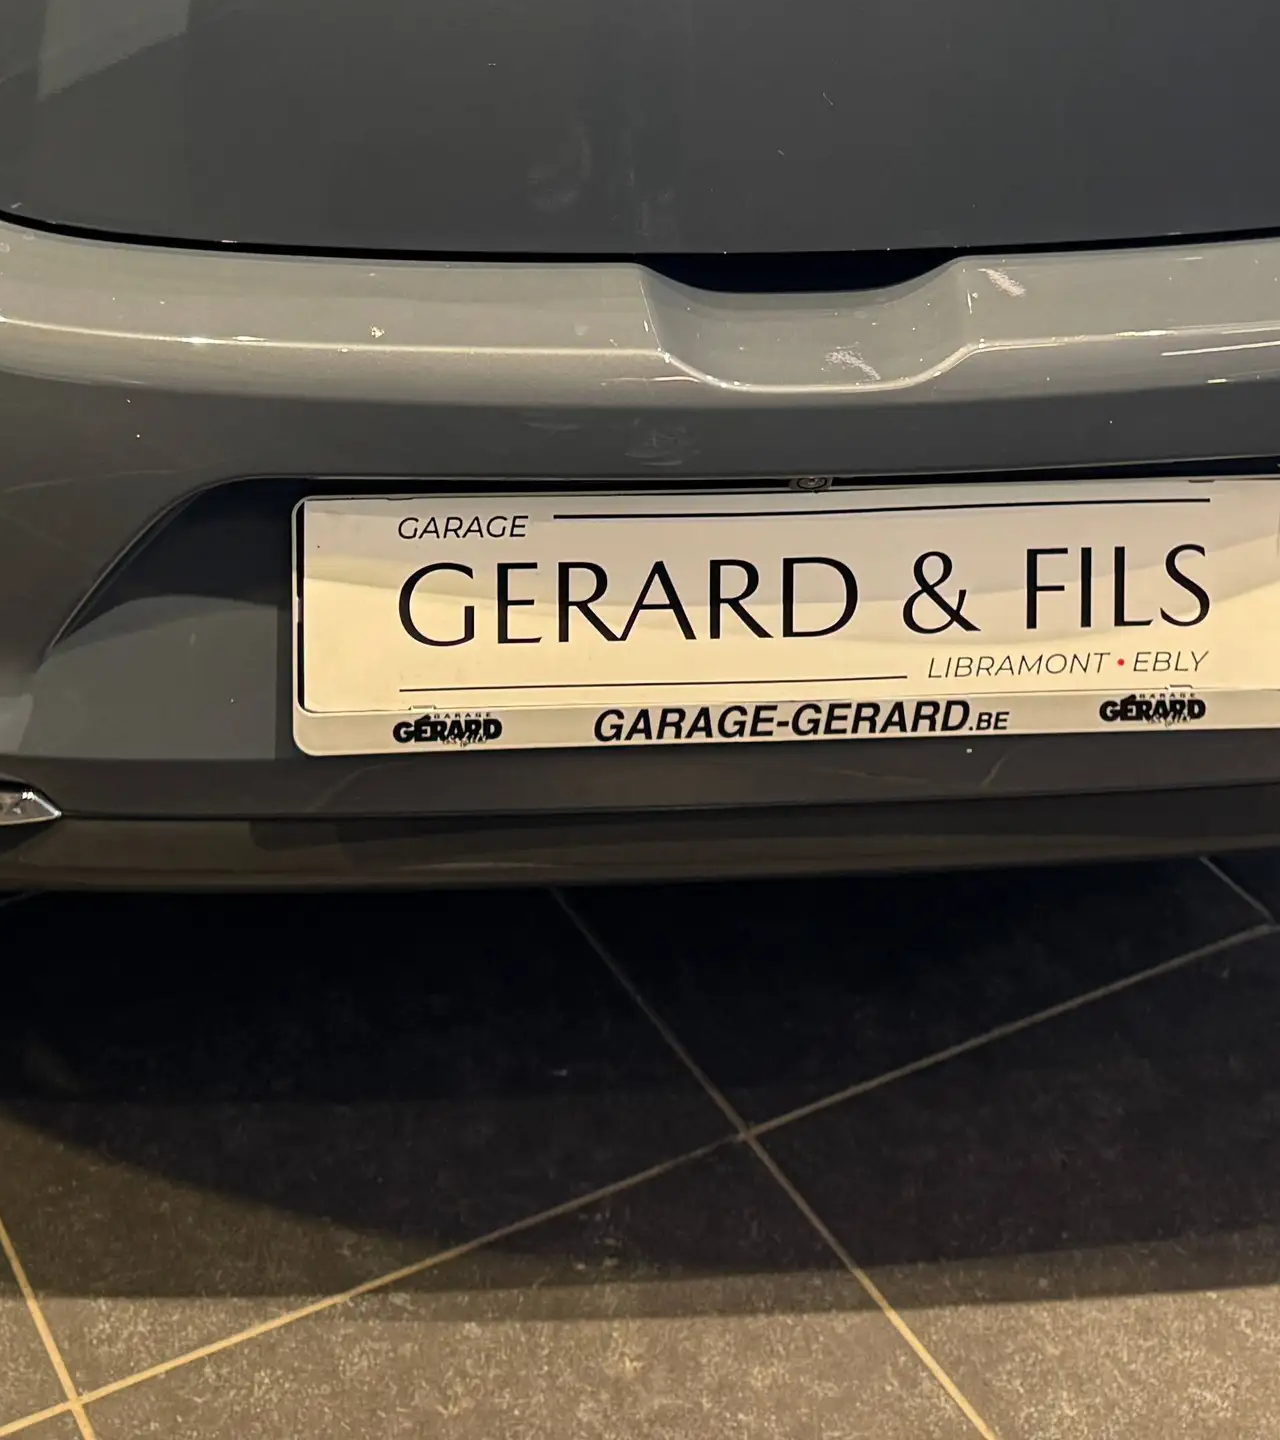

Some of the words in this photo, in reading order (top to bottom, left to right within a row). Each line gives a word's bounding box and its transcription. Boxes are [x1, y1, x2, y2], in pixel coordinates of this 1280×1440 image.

[397, 514, 529, 540] GARAGE
[397, 555, 859, 648] GERARD
[902, 550, 982, 635] &
[1025, 542, 1211, 631] FILS
[927, 650, 1112, 680] LIBRAMONT
[1132, 648, 1210, 674] EBLY
[593, 698, 1010, 743] GARAGE-GERARD.BE
[1098, 693, 1207, 723] GÉRARD
[392, 714, 503, 744] GÉRARD
